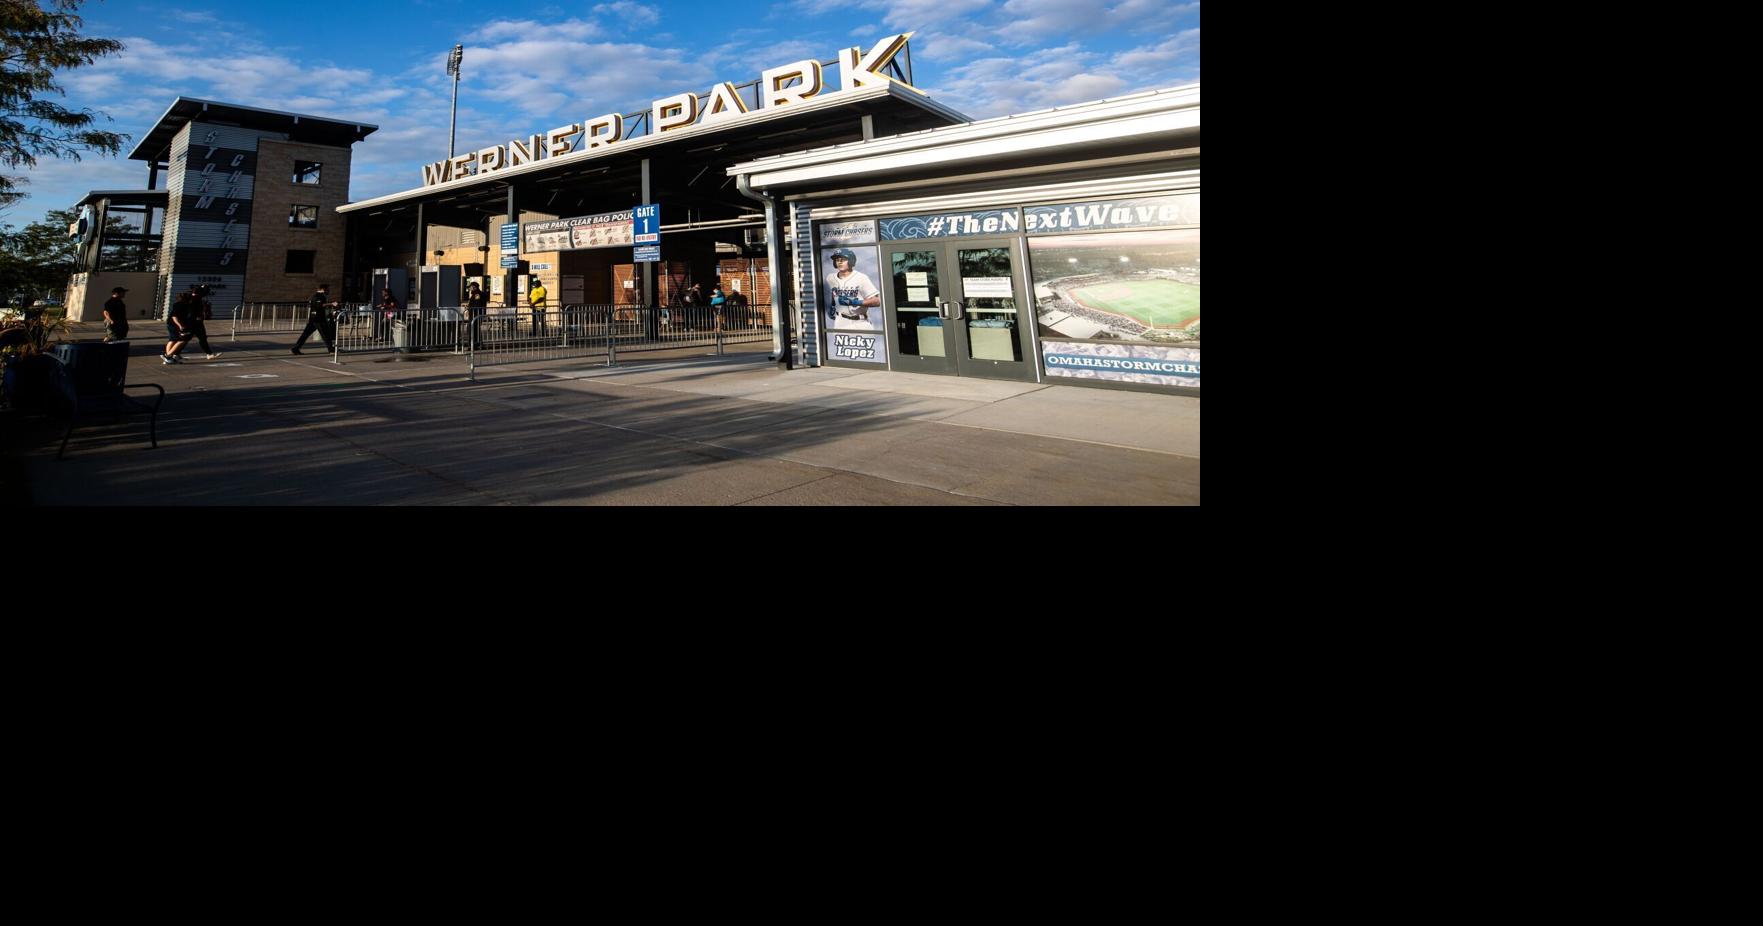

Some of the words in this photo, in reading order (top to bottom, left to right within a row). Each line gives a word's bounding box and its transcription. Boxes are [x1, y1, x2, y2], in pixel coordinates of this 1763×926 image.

[421, 112, 623, 187] WERNER
[652, 31, 922, 133] PARK
[195, 130, 218, 209] STORM
[220, 154, 244, 266] CHASERS
[637, 206, 655, 218] GATE
[525, 223, 549, 231] WERNER
[551, 220, 569, 228] PARK
[570, 217, 591, 226] CLEAR
[593, 215, 610, 224] BAG
[643, 218, 649, 233] 1
[926, 203, 1180, 237] #TheNextWave
[823, 228, 844, 238] STORM
[845, 226, 873, 236] CHASERS
[835, 335, 875, 349] Nicky
[837, 346, 875, 359] Lopez
